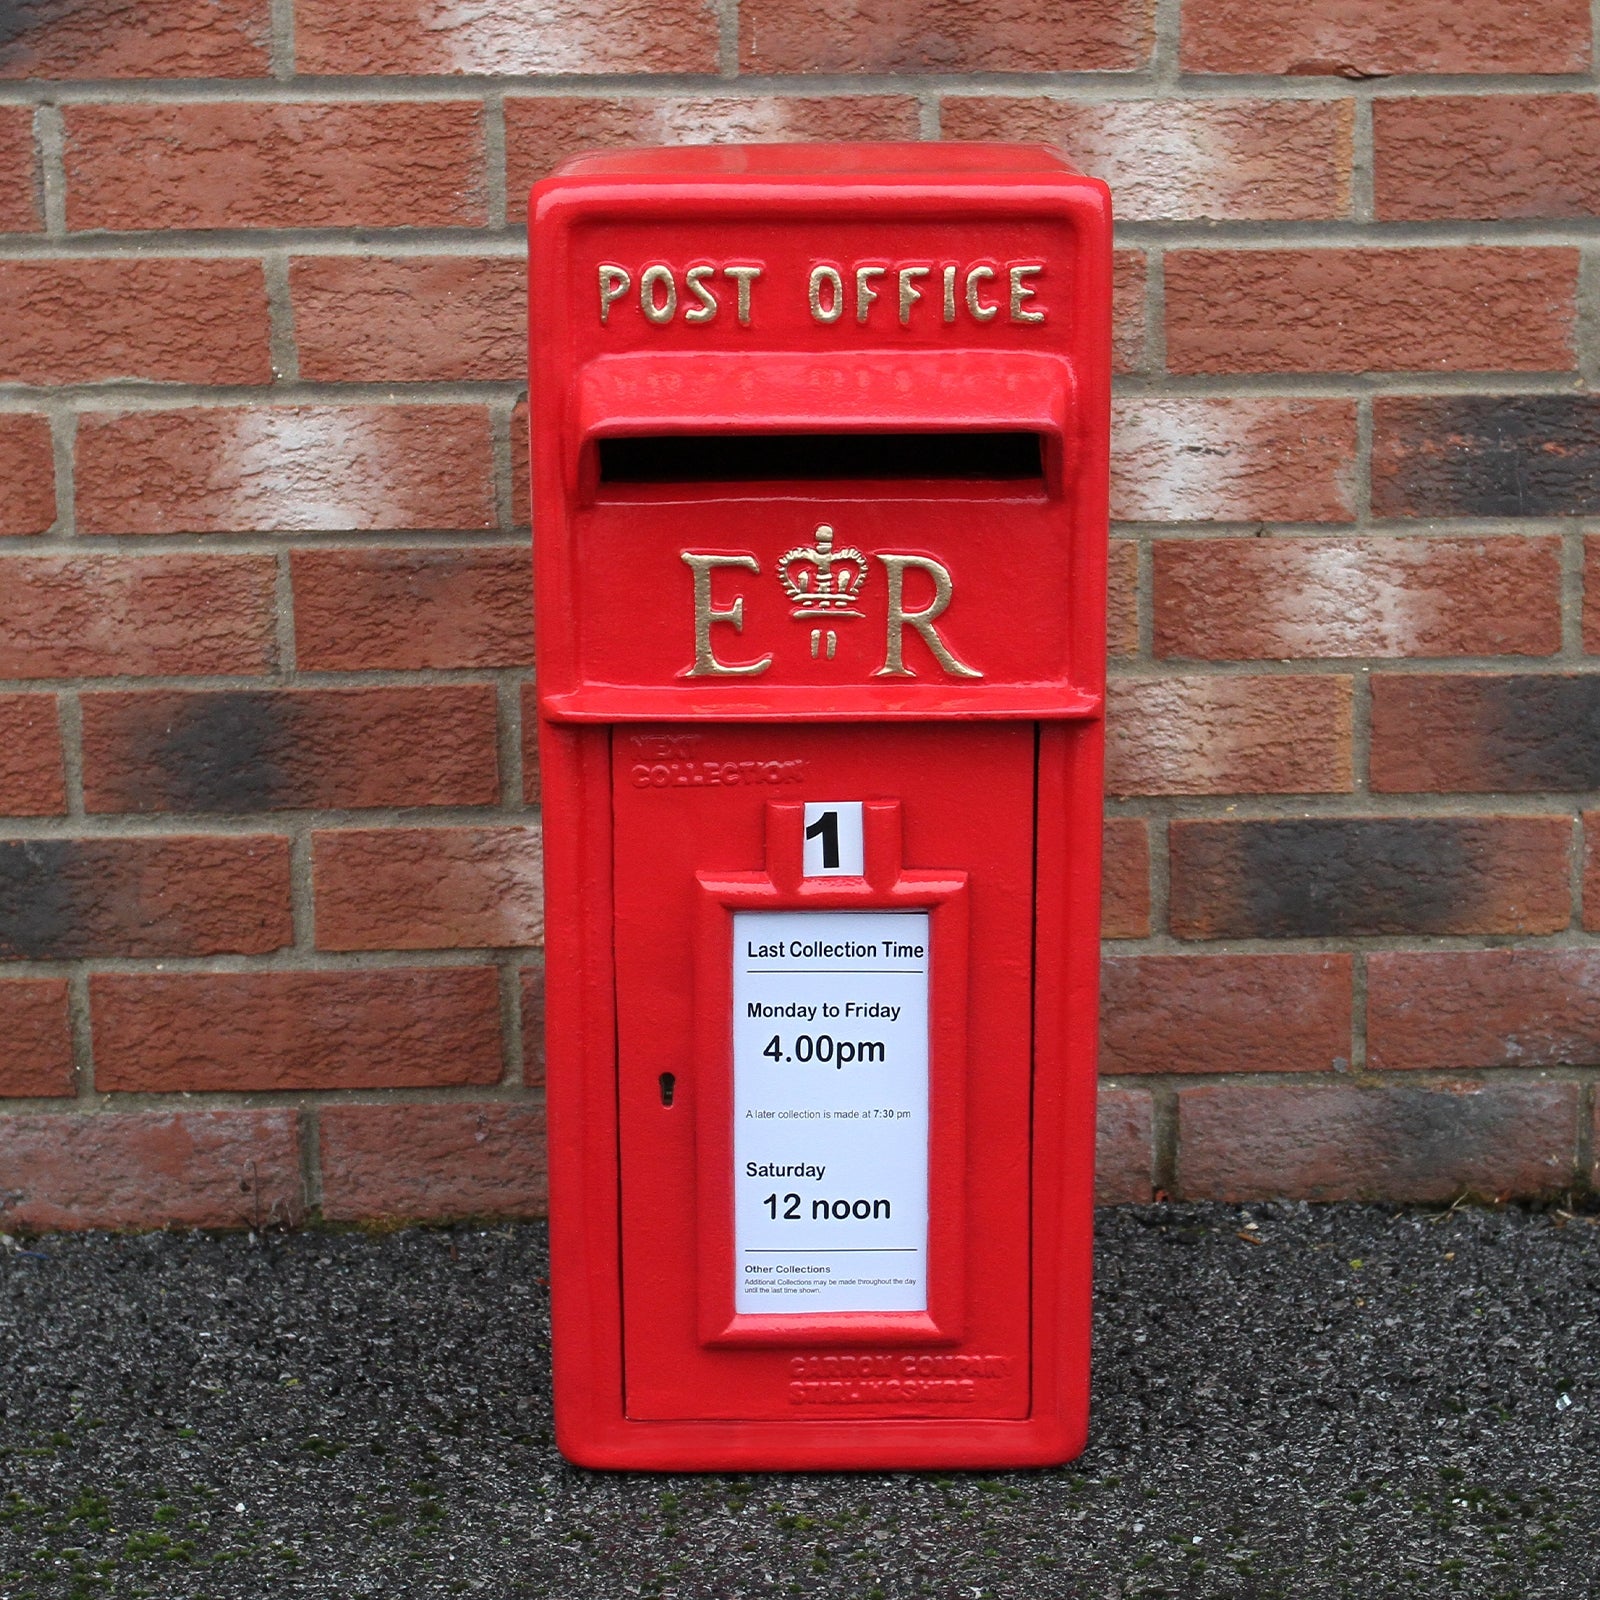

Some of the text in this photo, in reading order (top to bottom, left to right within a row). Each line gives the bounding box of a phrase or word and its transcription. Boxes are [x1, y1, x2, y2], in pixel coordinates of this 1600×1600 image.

[598, 264, 1046, 324] POST OFFICE
[681, 551, 985, 679] E R
[631, 760, 807, 789] COLLECTION
[805, 811, 840, 869] 1
[747, 940, 925, 959] Last Collection Time
[747, 1001, 902, 1022] Monday to Friday
[762, 1034, 885, 1070] 4.00pm
[746, 1109, 911, 1120] A later collection is made at 7:30 pm
[745, 1161, 827, 1182] Saturday
[763, 1192, 891, 1221] 12 noon
[745, 1265, 830, 1273] Other Collections
[745, 1278, 776, 1286] Additional
[777, 1278, 812, 1286] Collections
[813, 1279, 827, 1287] may
[838, 1278, 856, 1286] made
[858, 1278, 891, 1287] throughout
[905, 1278, 916, 1287] day
